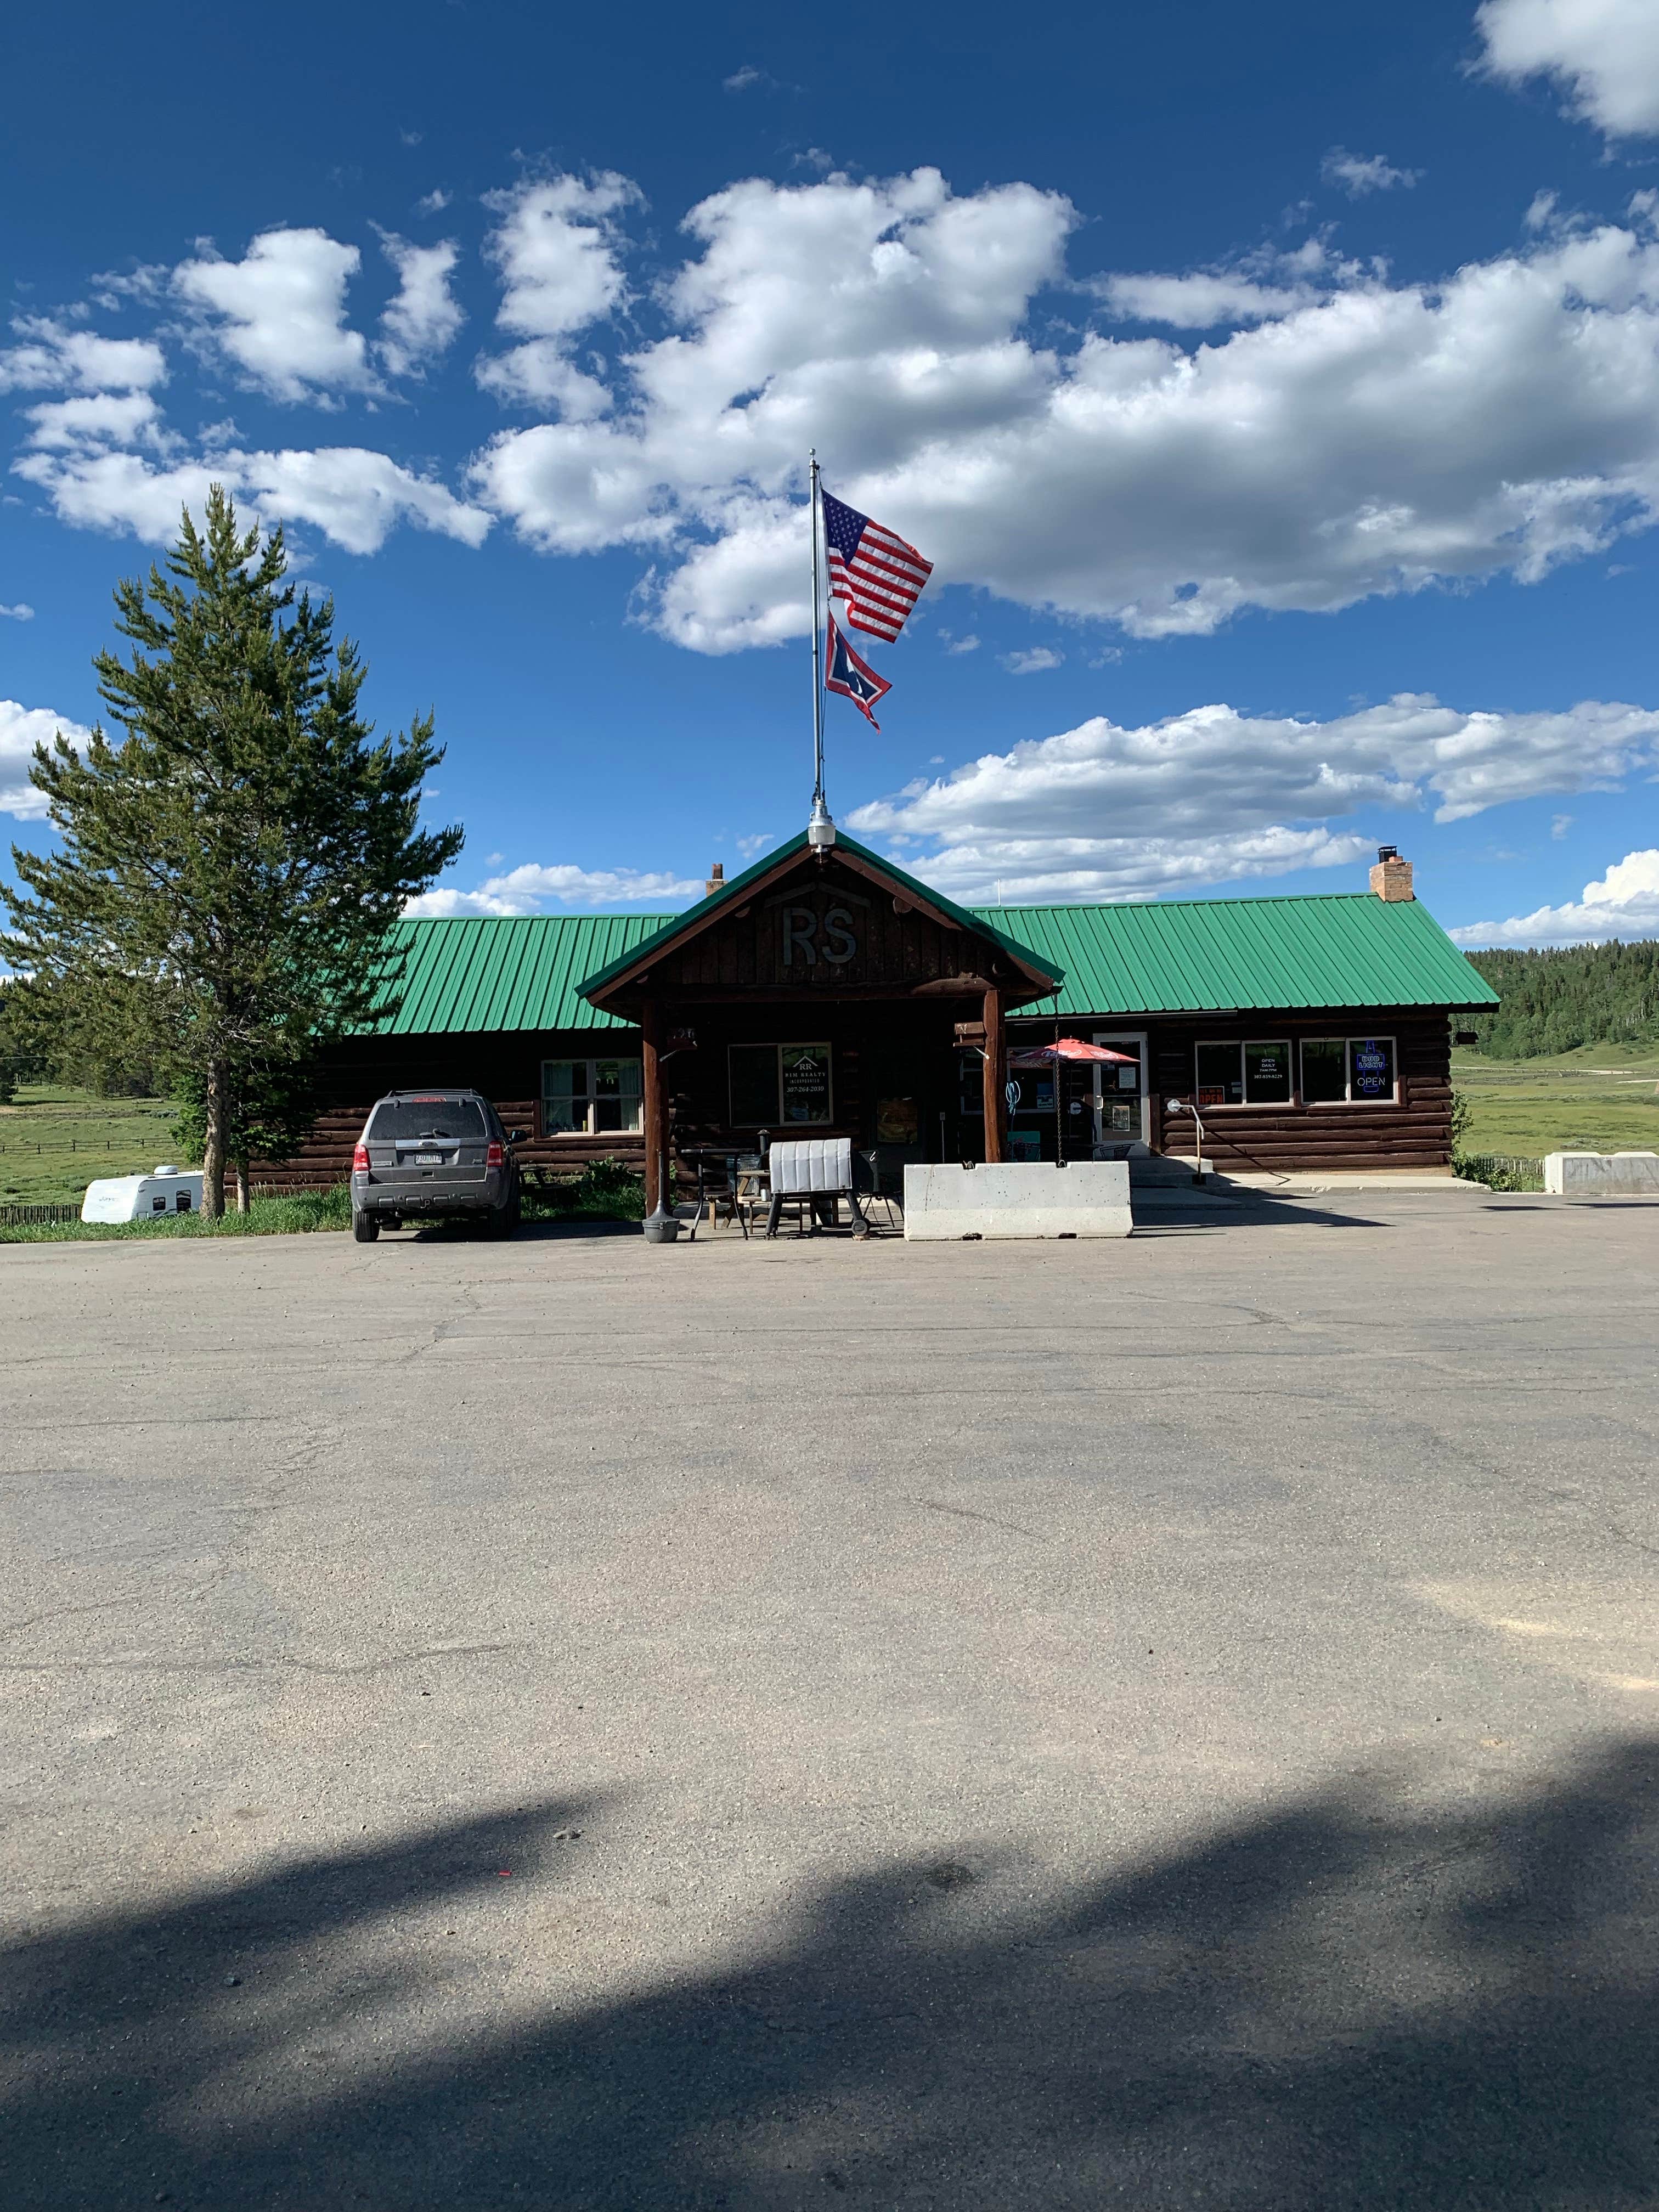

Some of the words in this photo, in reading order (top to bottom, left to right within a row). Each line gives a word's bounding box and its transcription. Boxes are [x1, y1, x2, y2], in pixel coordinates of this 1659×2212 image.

[783, 907, 856, 966] RS
[1357, 1077, 1385, 1086] OPEN
[1199, 1094, 1223, 1104] OPEN
